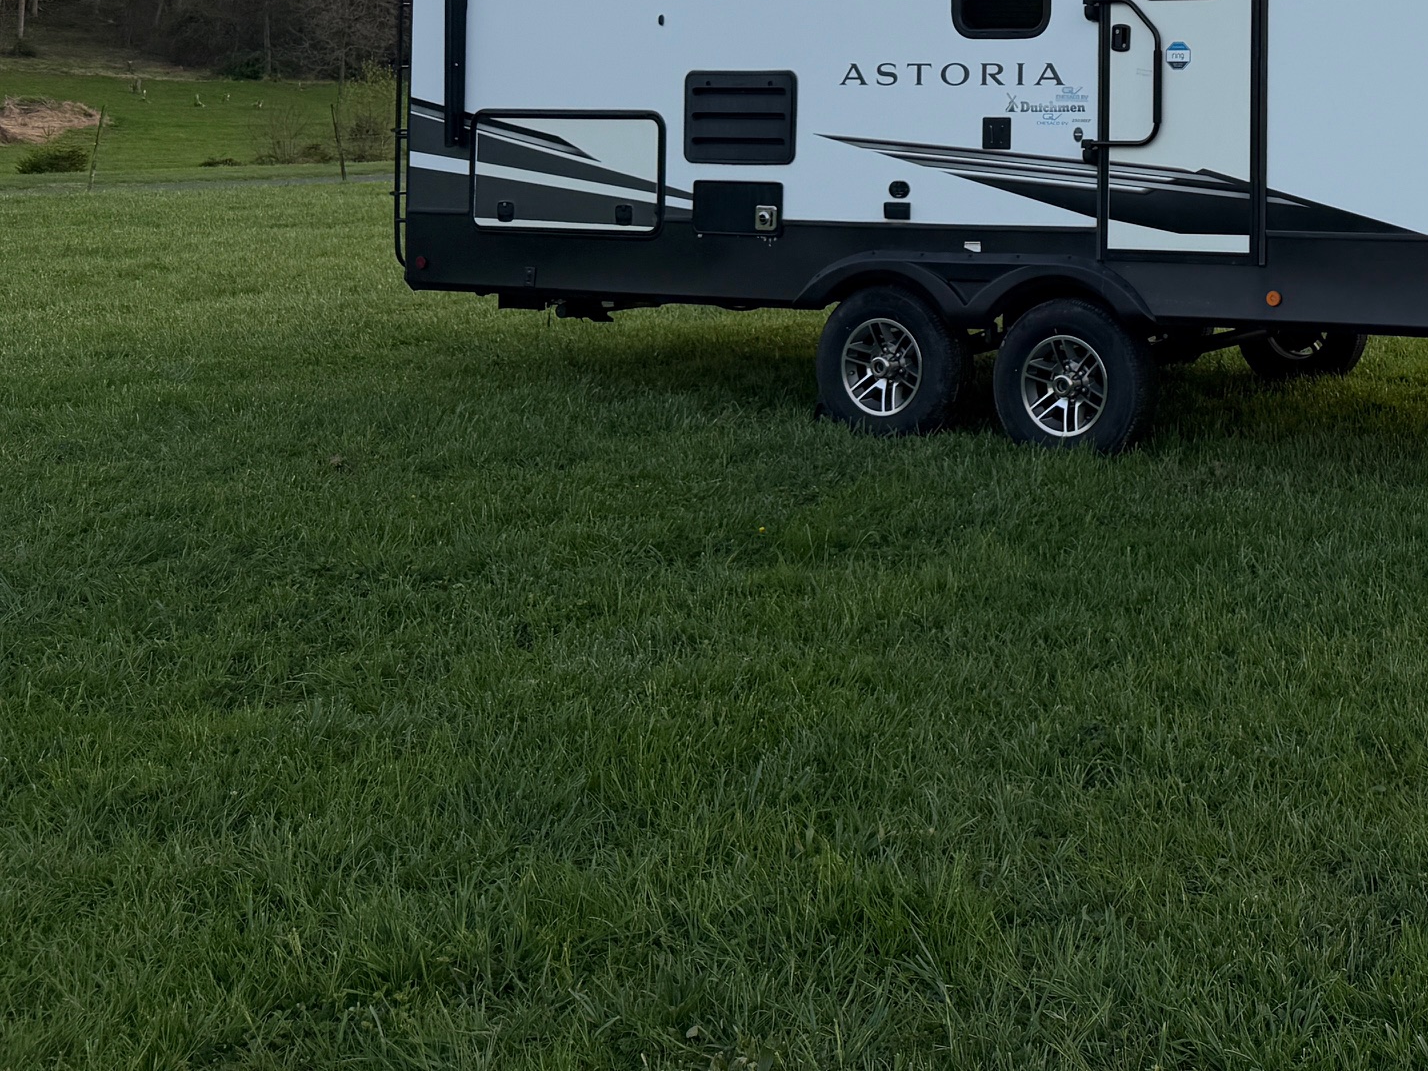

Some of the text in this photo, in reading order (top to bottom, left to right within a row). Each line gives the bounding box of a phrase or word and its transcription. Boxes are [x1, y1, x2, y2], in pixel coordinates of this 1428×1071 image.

[1171, 52, 1185, 60] ring
[839, 62, 1066, 87] ASTORIA
[1020, 101, 1086, 113] Dutchmen
